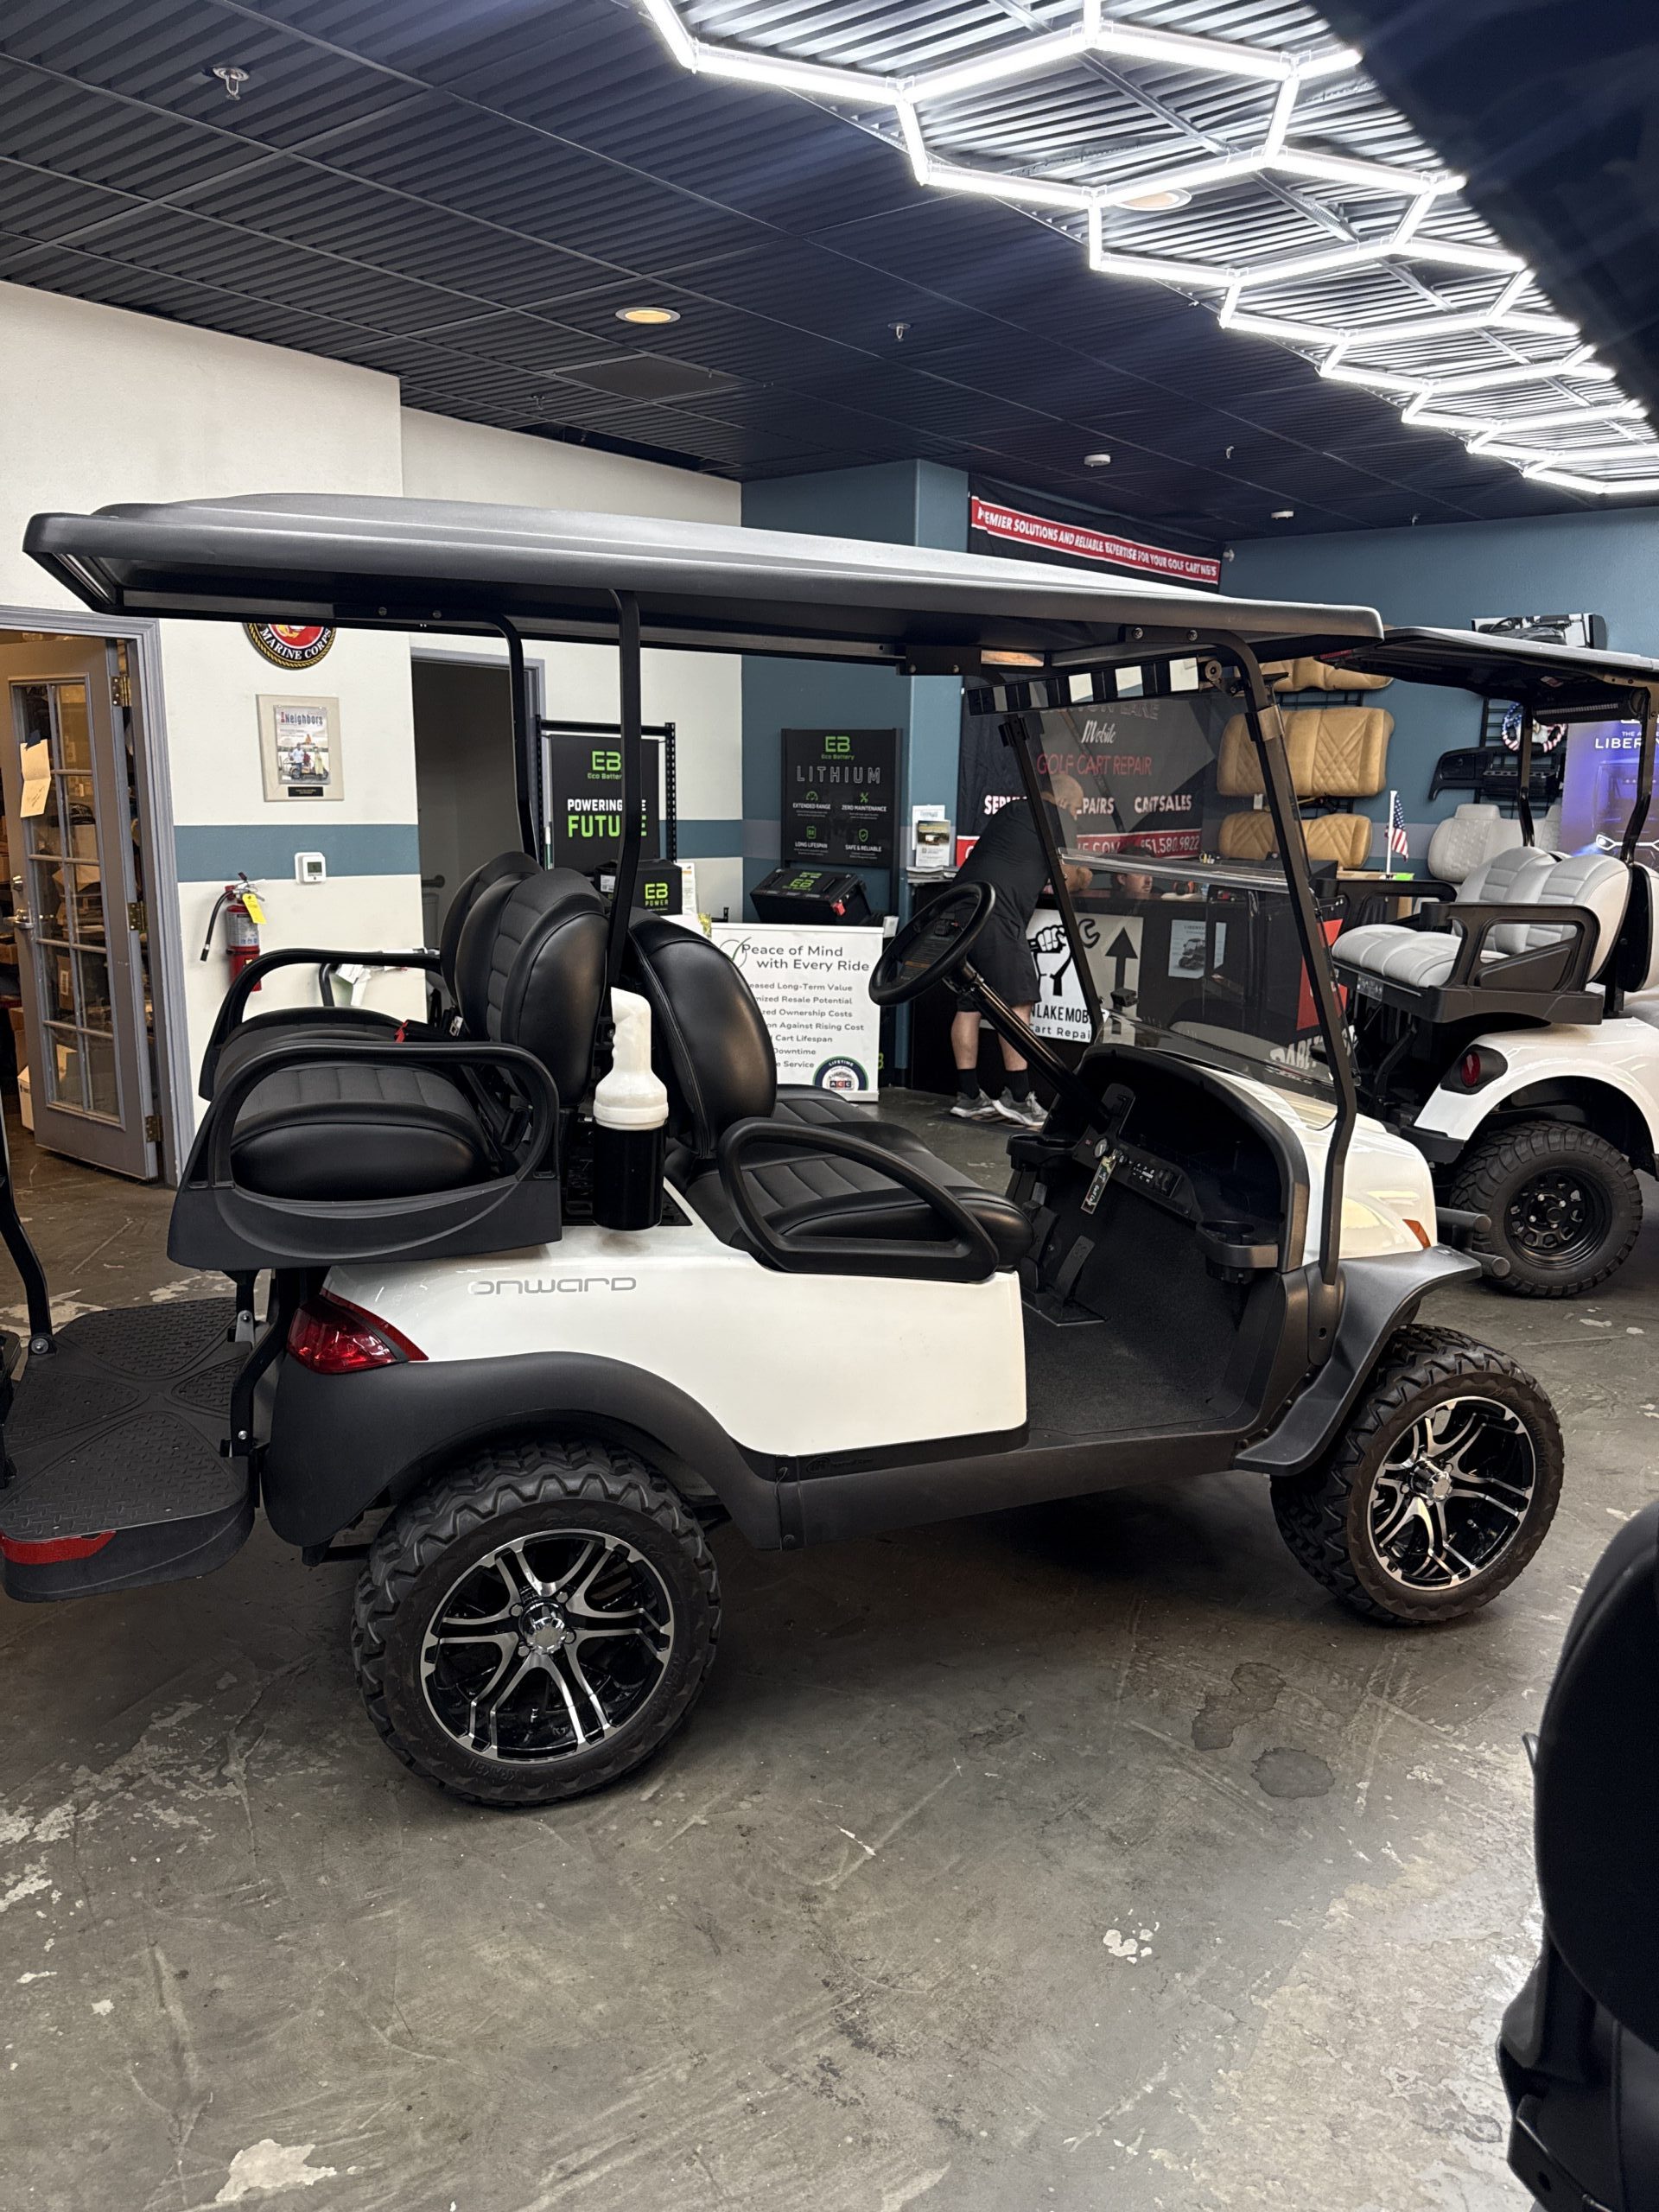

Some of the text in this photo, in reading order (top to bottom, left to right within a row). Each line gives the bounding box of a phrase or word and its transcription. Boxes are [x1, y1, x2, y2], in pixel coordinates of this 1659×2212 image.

[1014, 518, 1058, 542] SOLUTIONS
[1058, 531, 1074, 545] AND
[1075, 534, 1104, 552] RELIABLE
[1138, 550, 1150, 564] FOR
[1150, 554, 1168, 568] YOUR
[1167, 557, 1185, 570] GOLF
[260, 627, 332, 660] MARINE CORPS
[1081, 720, 1116, 744] Mobile
[825, 736, 850, 753] EB
[1595, 737, 1659, 749] LIBER
[592, 751, 621, 772] EB
[1037, 752, 1152, 776] GOLF CART REPAIR
[797, 766, 880, 785] LITHIUM
[567, 798, 623, 811] POWERING
[1077, 797, 1115, 815] PAIRS
[568, 815, 646, 837] FUTU
[645, 882, 669, 899] EB
[741, 944, 843, 957] Peace of Mind
[756, 957, 869, 972] with Every Ride
[778, 982, 825, 992] Long-Term
[827, 983, 853, 992] Value
[813, 996, 853, 1005] Potential
[779, 1008, 826, 1018] Ownership
[815, 1023, 842, 1032] Rising
[1057, 1027, 1091, 1040] Repai
[797, 1035, 833, 1044] Lifespan
